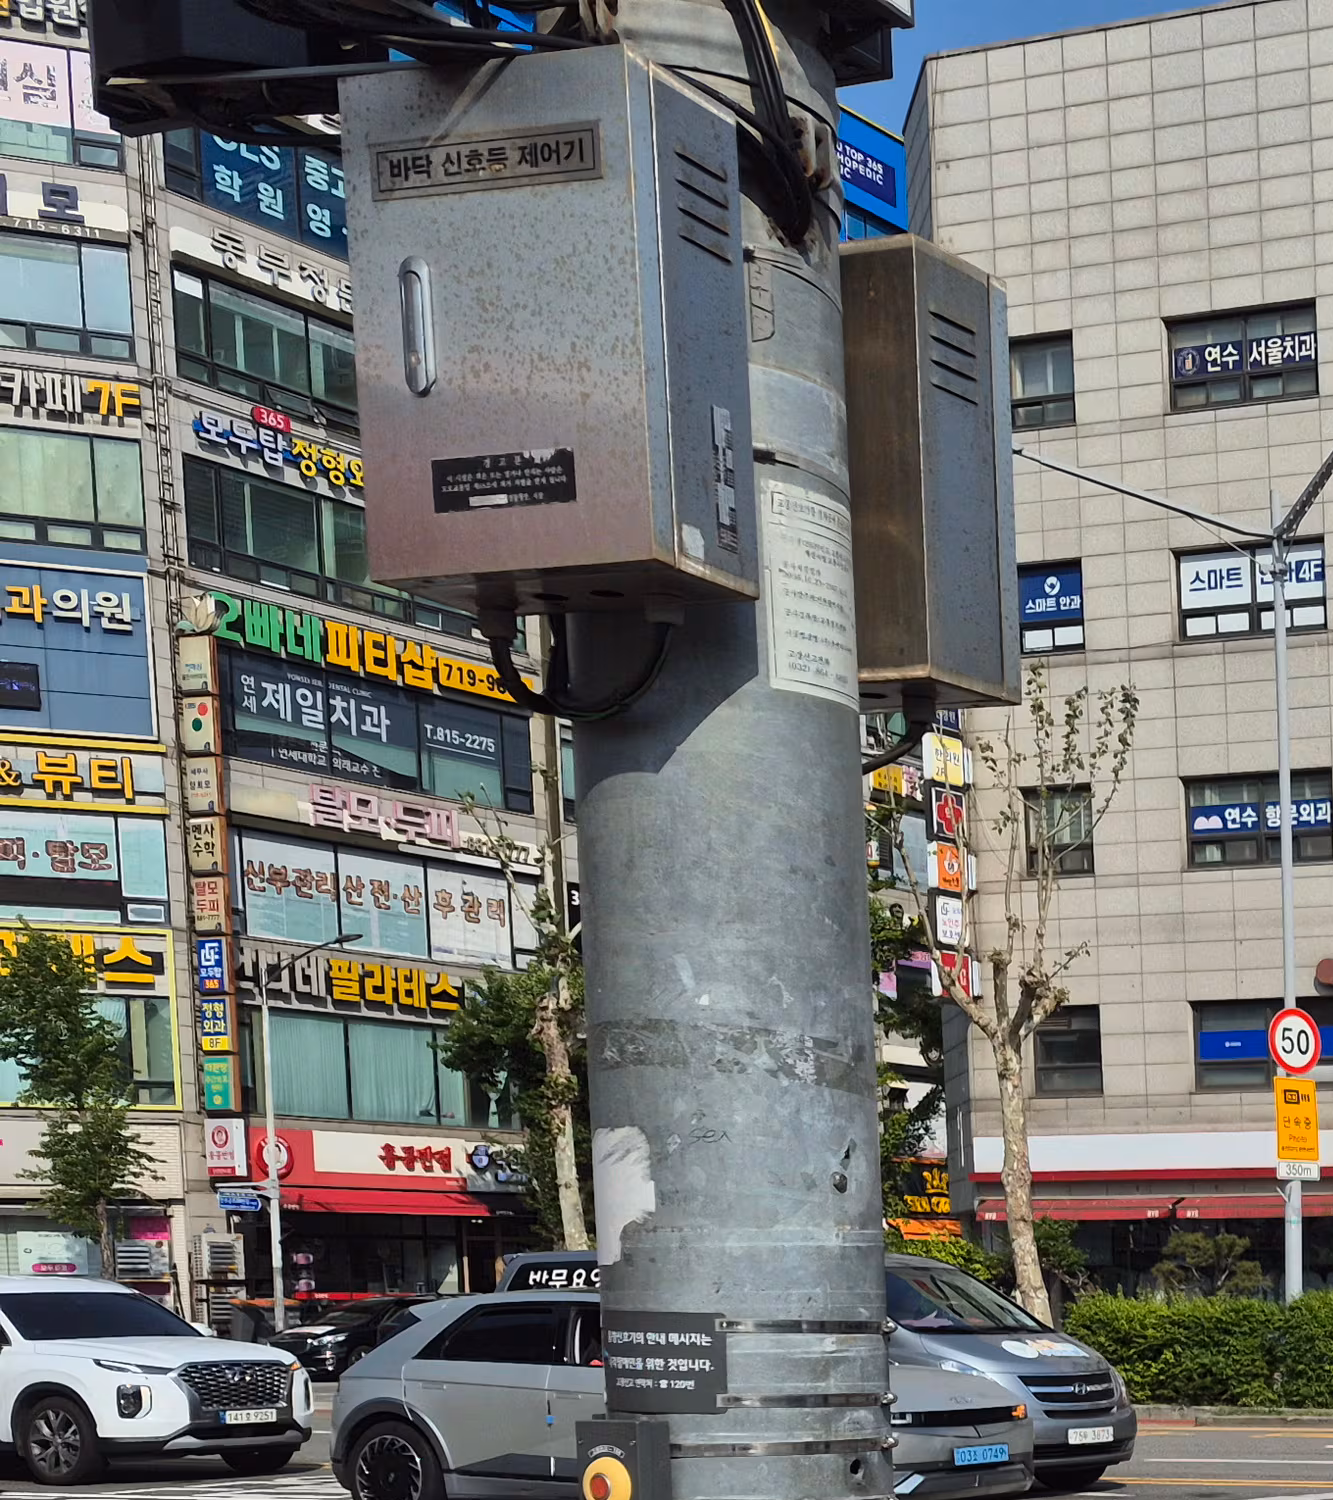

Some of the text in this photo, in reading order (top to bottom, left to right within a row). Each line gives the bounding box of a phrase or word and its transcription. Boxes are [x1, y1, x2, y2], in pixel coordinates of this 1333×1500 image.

[389, 138, 585, 182] 바닥 신호등 제어기
[1204, 333, 1316, 372] 연수 서울치과
[86, 379, 140, 416] 7F
[259, 407, 285, 428] 365
[199, 411, 287, 467] 모두탑
[1189, 561, 1323, 592] 스마트 4F
[1025, 596, 1081, 613] 스마트 안과
[325, 620, 438, 690] 피티샵
[261, 682, 391, 742] 제일치과
[424, 724, 496, 753] T.815-2275
[32, 752, 135, 799] 뷰티
[1224, 806, 1258, 830] 연수
[192, 824, 215, 841] 멘사
[192, 842, 215, 857] 수학
[195, 880, 218, 896] 탈모
[245, 860, 337, 902] 신부관리
[196, 899, 219, 913] 두피
[204, 980, 220, 990] 365
[329, 959, 460, 1011] 필라테스
[201, 1002, 225, 1020] 정형
[202, 1020, 226, 1035] 외과
[208, 1037, 222, 1049] 8F
[1281, 1027, 1310, 1056] 50
[379, 1143, 452, 1172] 홍콩반점
[1286, 1164, 1312, 1176] 350m
[668, 1333, 713, 1346] 메시지는
[645, 1357, 715, 1372] 위한 것입니다.
